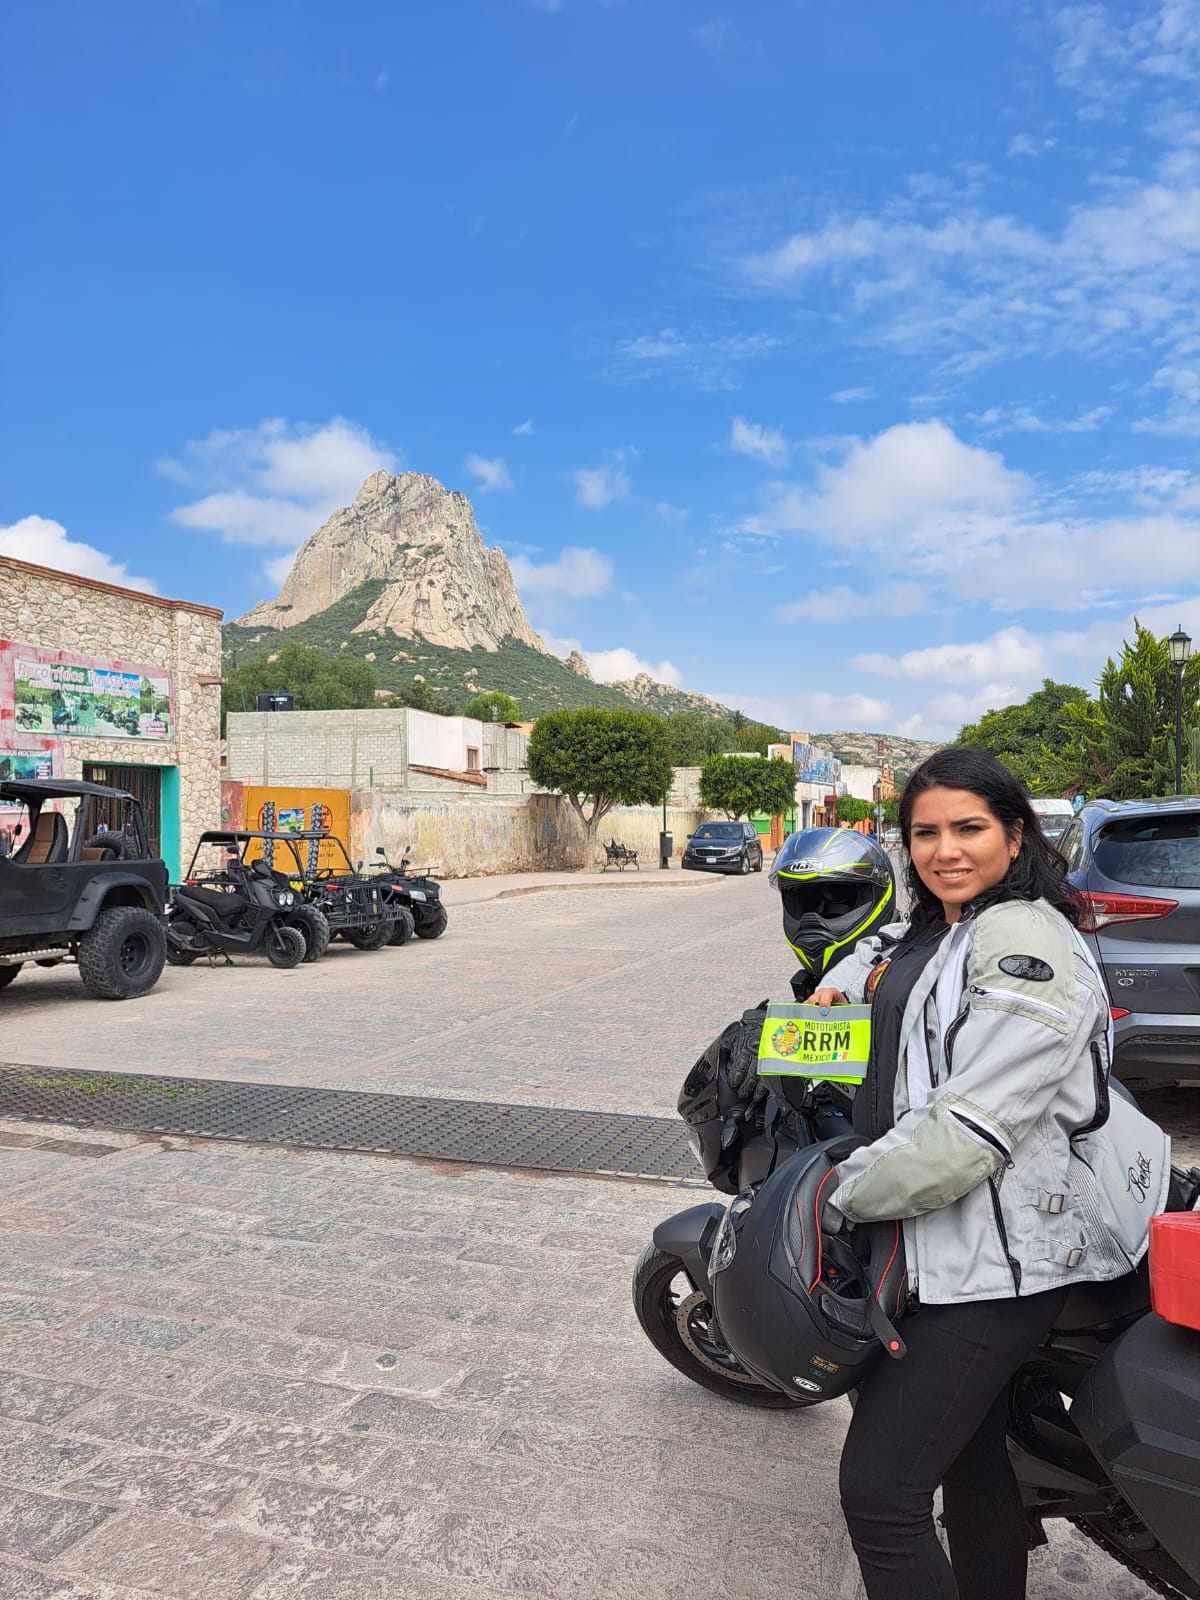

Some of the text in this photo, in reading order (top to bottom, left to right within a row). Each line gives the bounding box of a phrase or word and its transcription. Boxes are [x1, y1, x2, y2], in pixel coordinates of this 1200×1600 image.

[18, 662, 85, 684] Recorridos
[1115, 969, 1160, 977] HYUNDAI
[804, 1021, 851, 1031] MOTOTURISTA
[803, 1031, 851, 1051] RRM
